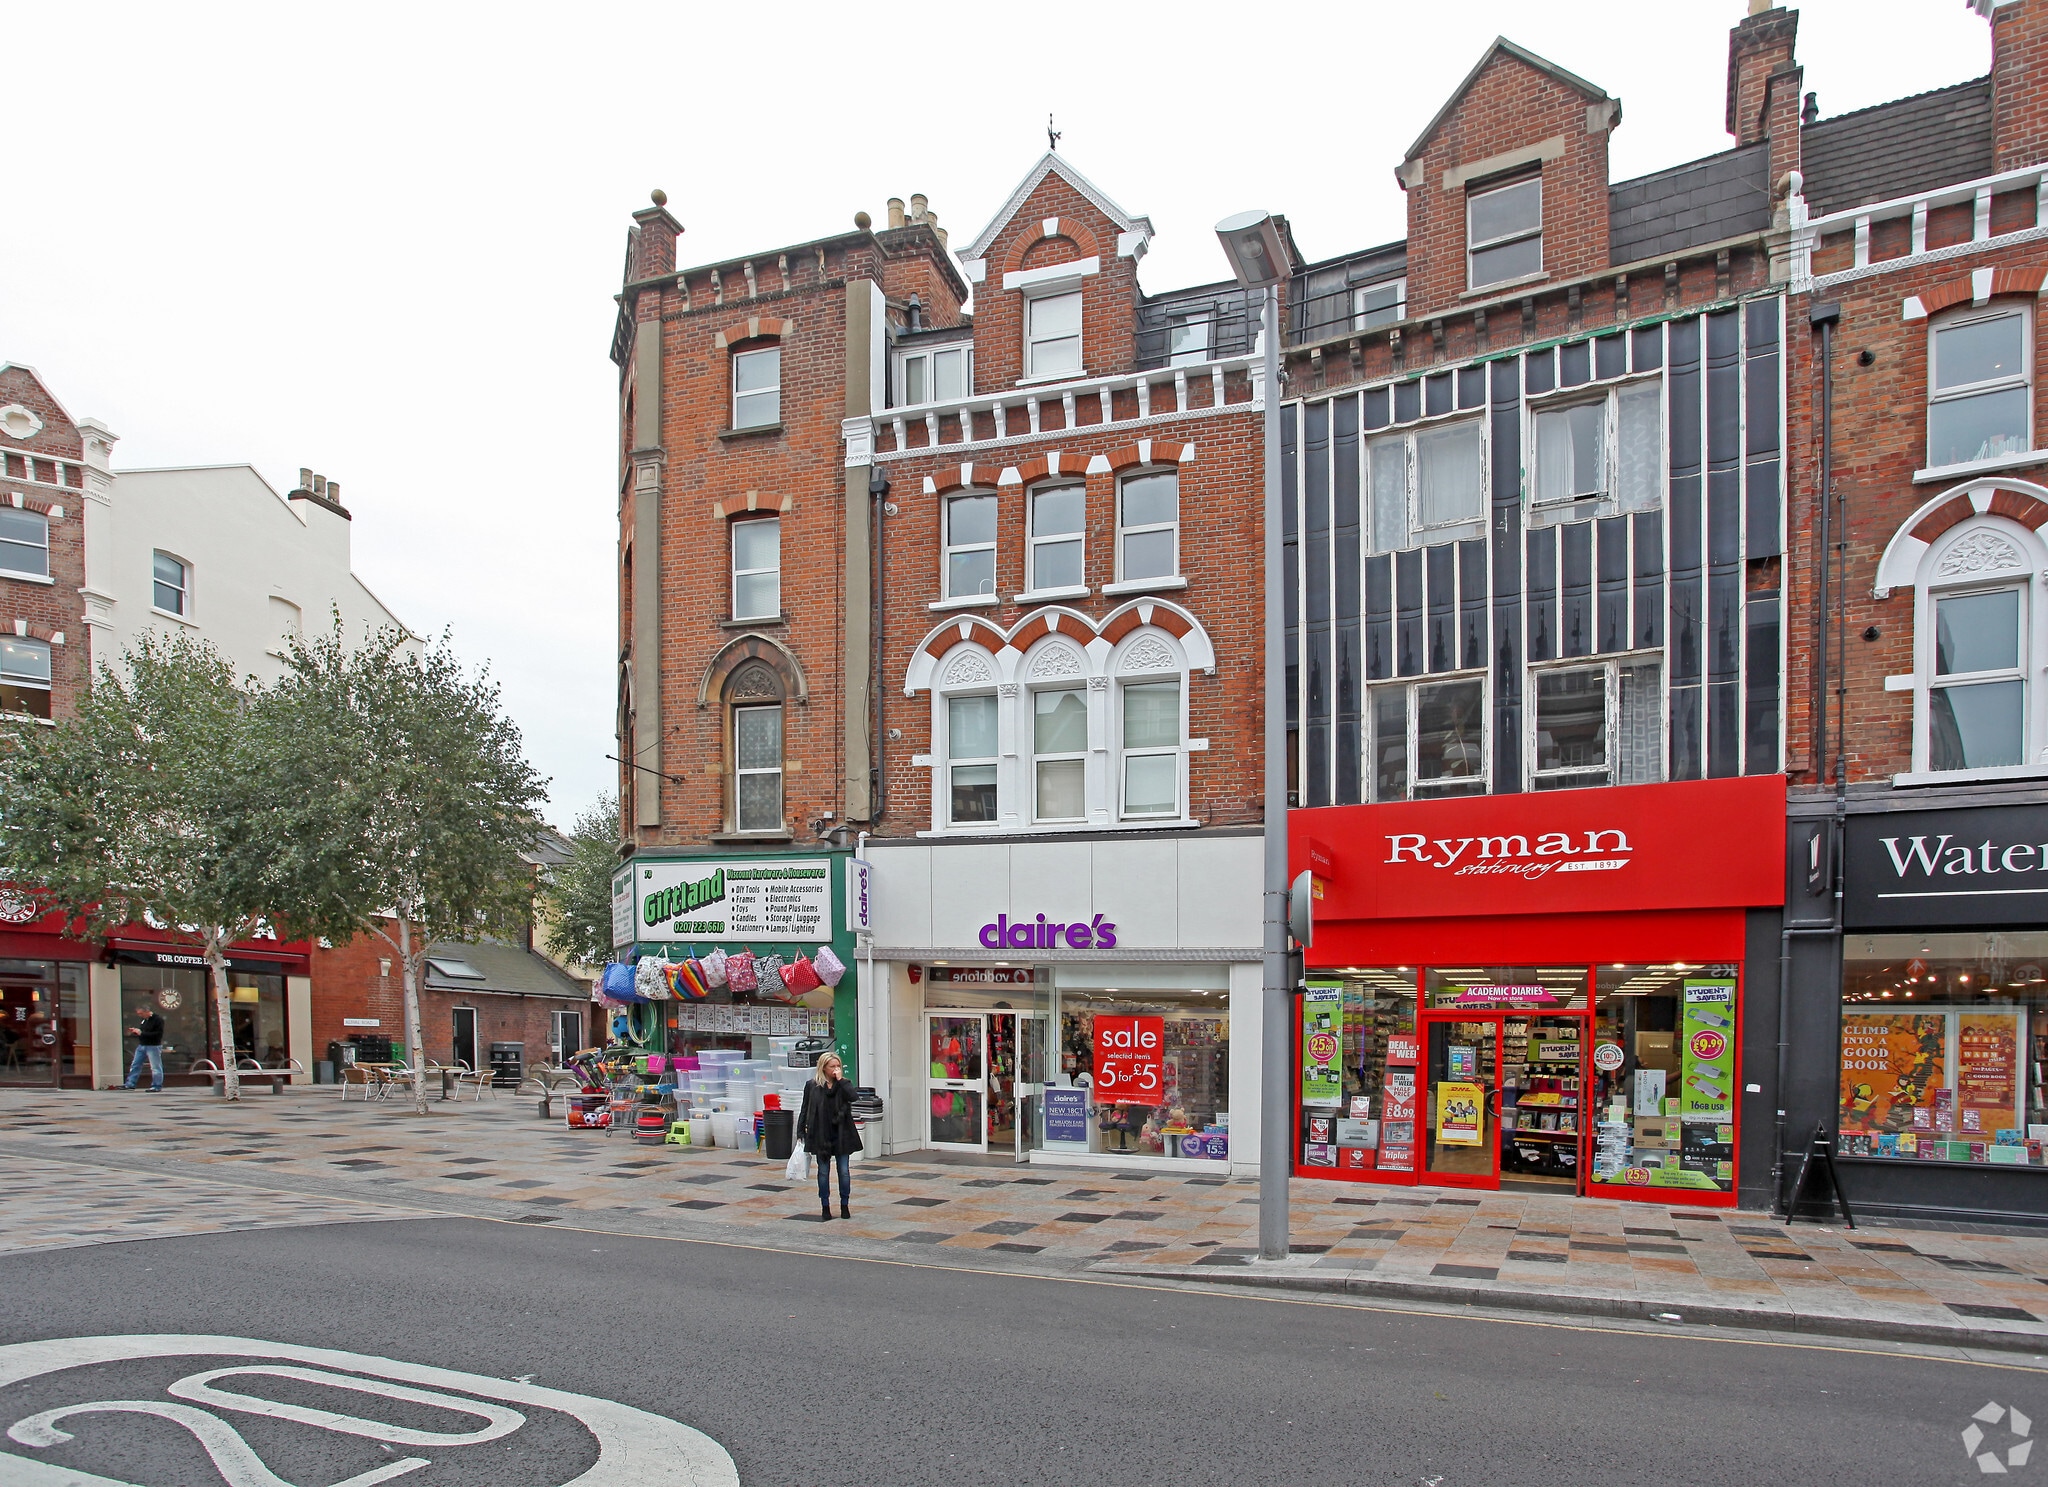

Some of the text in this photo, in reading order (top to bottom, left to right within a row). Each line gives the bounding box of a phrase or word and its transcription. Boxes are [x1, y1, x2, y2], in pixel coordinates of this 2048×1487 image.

[1384, 829, 1633, 868] Ryman
[727, 869, 752, 880] Discount
[753, 869, 782, 880] Hardware
[789, 868, 826, 879] Housewares
[1454, 859, 1562, 880] stationery
[1593, 860, 1619, 869] 1893
[770, 885, 823, 893] Mobile Accessories
[644, 868, 725, 927] Giftland
[858, 867, 868, 926] claire's
[736, 905, 749, 914] Toys
[788, 904, 801, 912] Plus
[736, 914, 757, 922] Candles
[770, 914, 792, 923] Storage
[797, 914, 821, 923] Luggage
[674, 921, 726, 933] 0207 223 6618
[736, 924, 764, 933] Stationery
[979, 912, 1117, 949] claire's
[157, 954, 173, 963] FOR
[174, 956, 202, 965] COFFEE
[1307, 988, 1336, 996] STUDENT
[1467, 987, 1543, 996] ACADEMIC DIARIES
[1687, 987, 1726, 996] STUDENT
[1314, 993, 1338, 1001] SAVERS
[1696, 993, 1728, 1001] SAVERS
[1102, 1020, 1157, 1049] sale
[1843, 1026, 1889, 1035] CLIMB
[1389, 1040, 1409, 1050] DEAL
[1693, 1038, 1723, 1052] £9.99
[1843, 1037, 1873, 1045] INTO
[1540, 1044, 1576, 1053] STUDENT
[1843, 1048, 1889, 1058] GOOD
[1107, 1052, 1151, 1060] selected items
[1843, 1060, 1889, 1070] BOOK
[1098, 1062, 1117, 1087] 5
[1118, 1070, 1133, 1082] for
[1691, 1101, 1709, 1110] 16GB
[1067, 1107, 1084, 1115] 18CT
[1386, 1103, 1415, 1118] £8.99
[1385, 1150, 1408, 1160] Triplus
